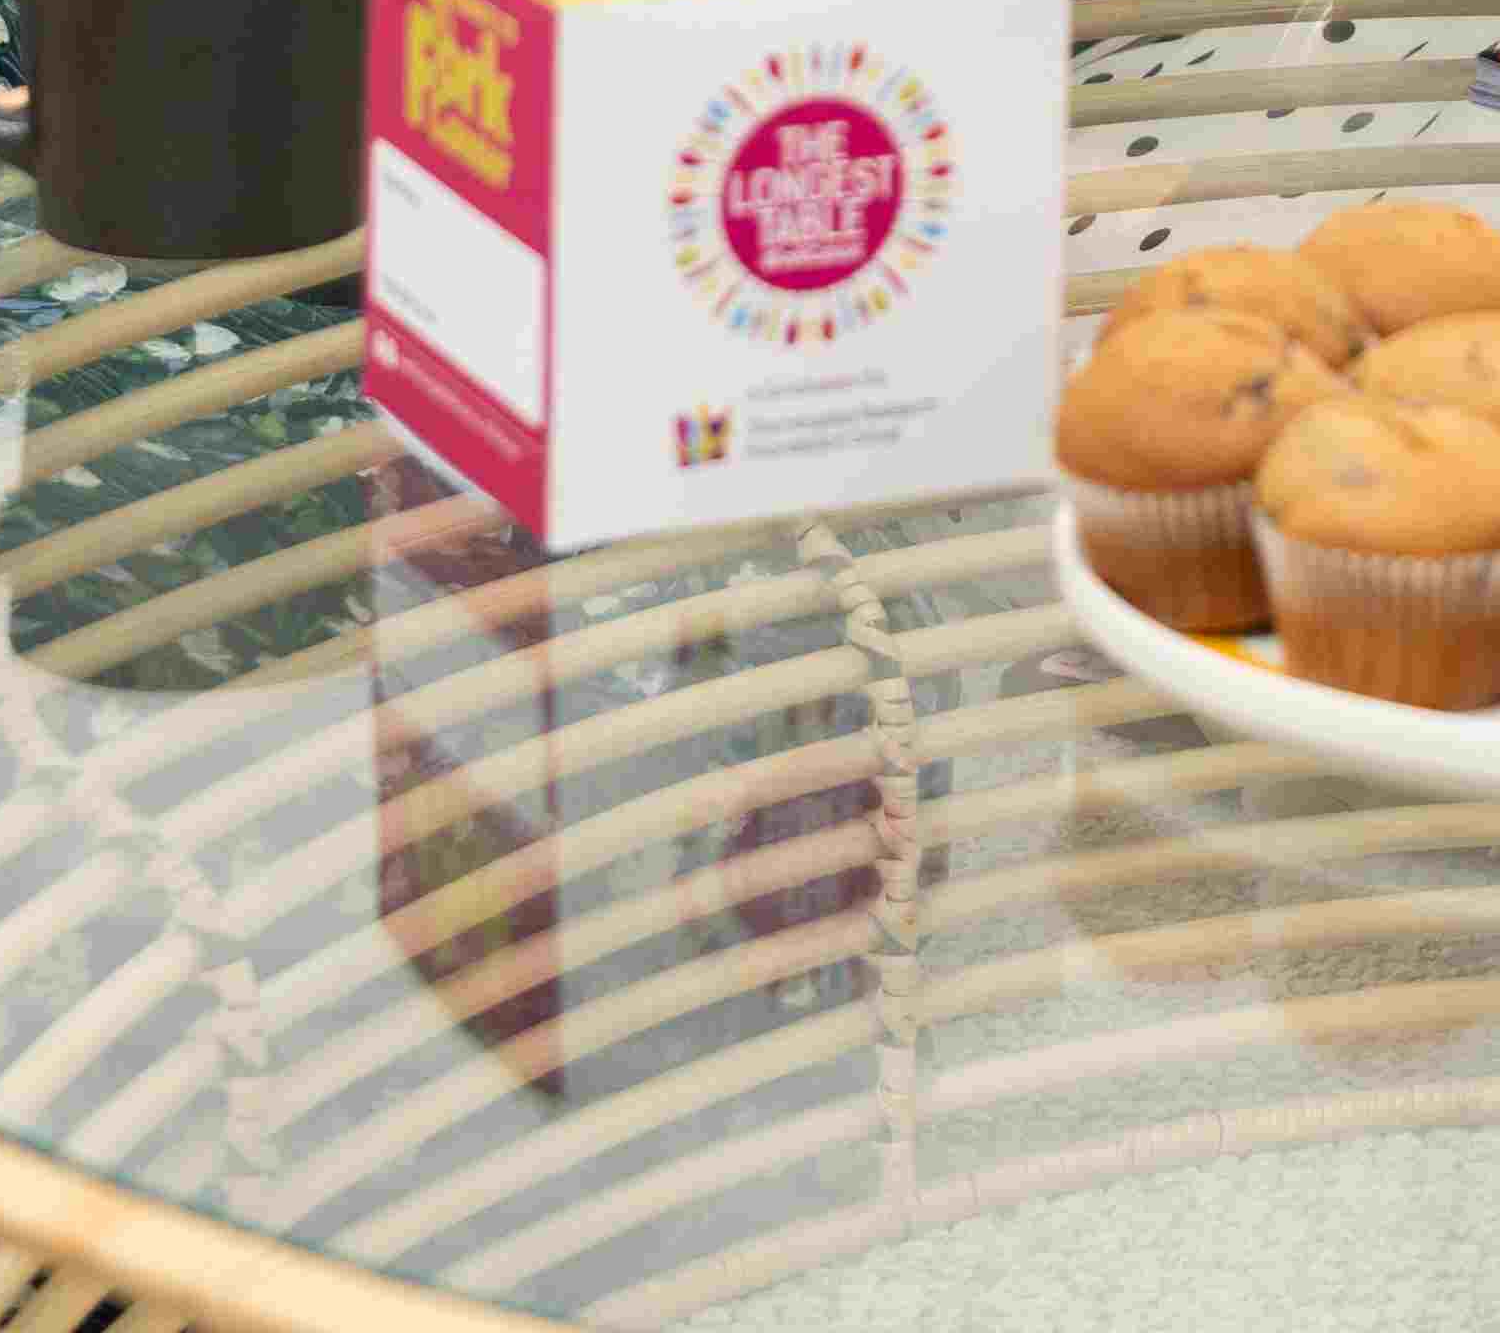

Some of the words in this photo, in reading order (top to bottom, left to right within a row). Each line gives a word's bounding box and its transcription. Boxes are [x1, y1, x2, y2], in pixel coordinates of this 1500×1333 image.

[780, 121, 850, 169] THE
[729, 155, 901, 214] LONGEST
[758, 199, 868, 247] TABLE
